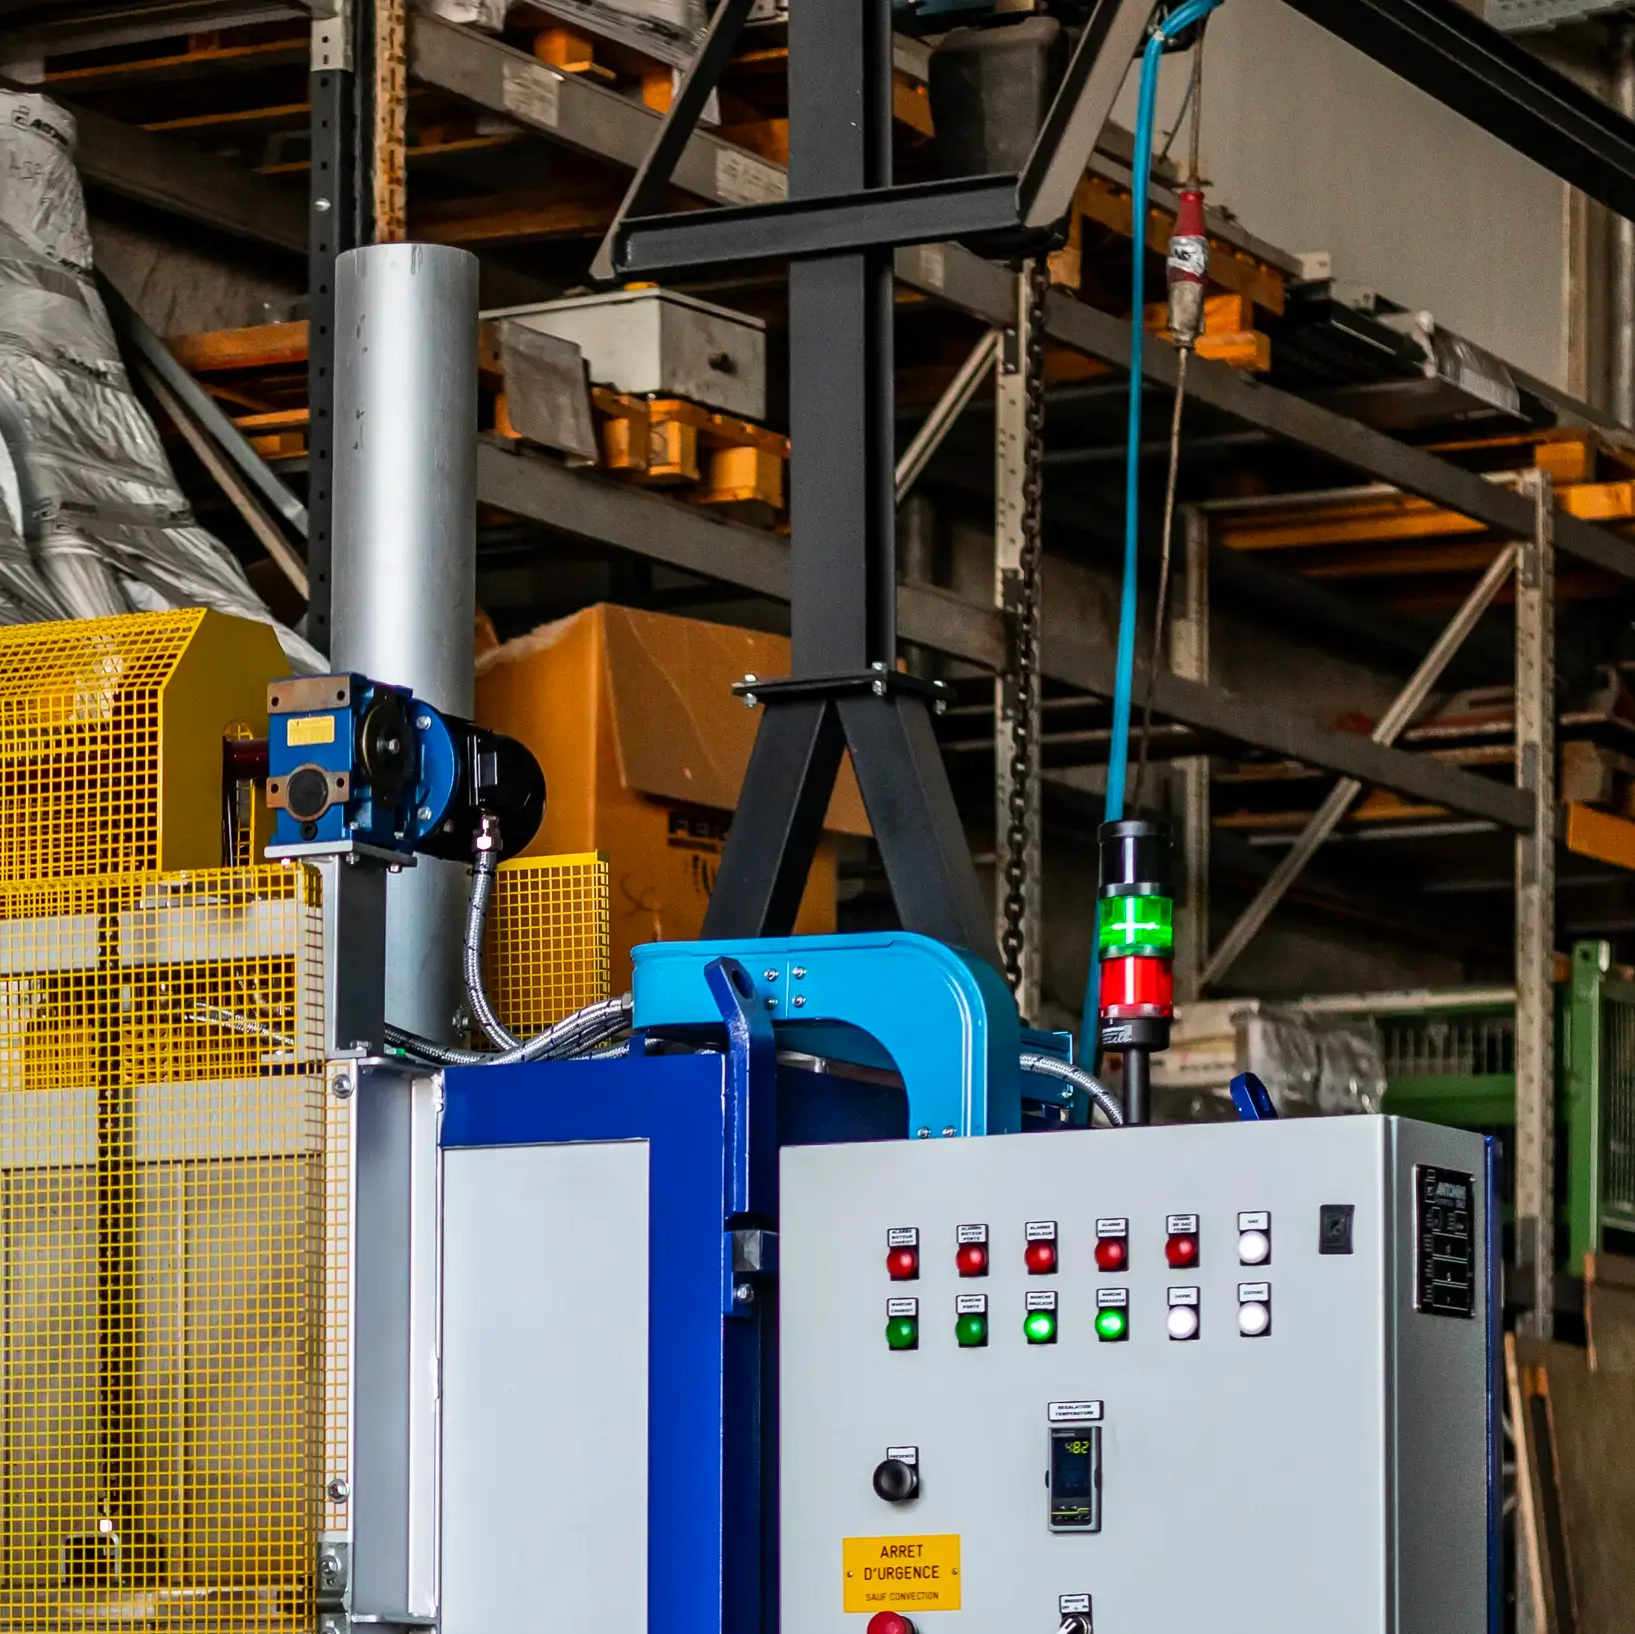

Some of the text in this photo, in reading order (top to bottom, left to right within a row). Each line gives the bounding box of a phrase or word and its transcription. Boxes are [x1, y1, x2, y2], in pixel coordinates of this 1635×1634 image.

[1065, 1441, 1090, 1454] 482
[880, 1544, 924, 1559] ARRET
[864, 1565, 940, 1581] D'URGENCE
[866, 1591, 939, 1601] SAUF CONVECTION
